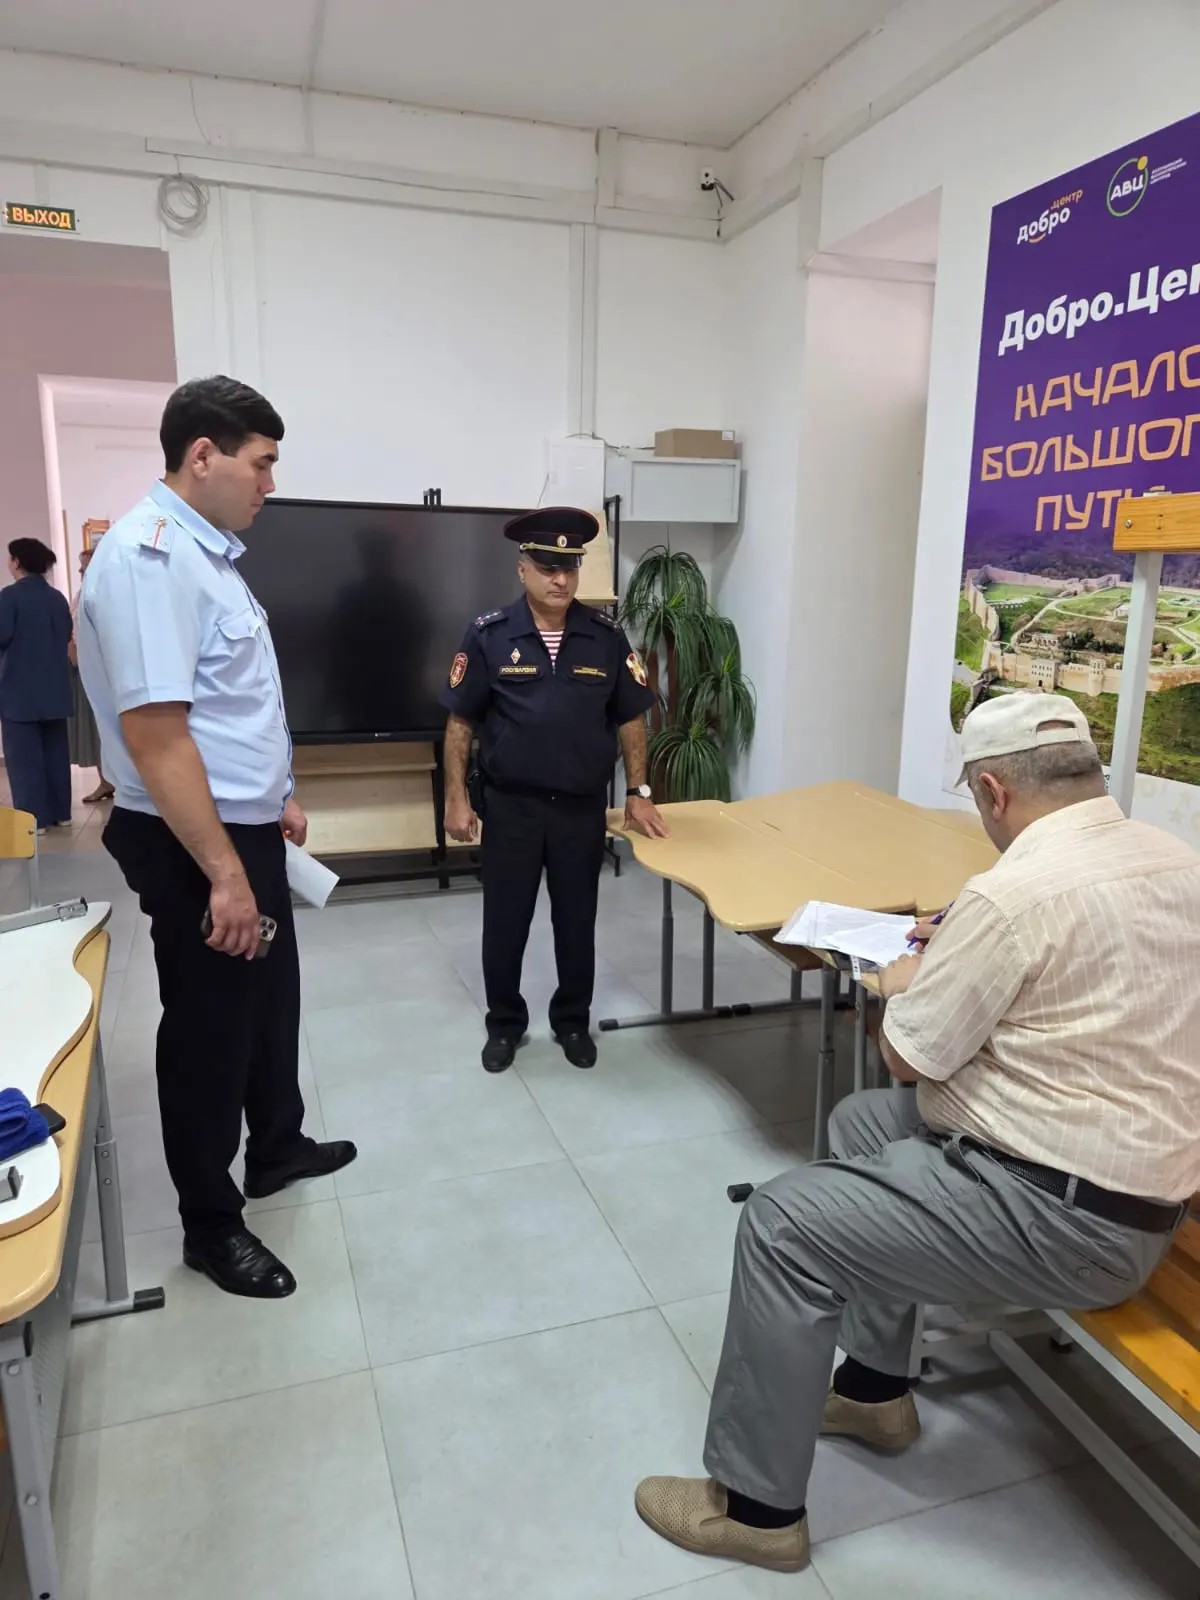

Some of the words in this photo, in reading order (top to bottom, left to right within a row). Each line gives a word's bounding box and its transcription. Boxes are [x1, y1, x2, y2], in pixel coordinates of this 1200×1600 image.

[1110, 174, 1145, 201] АВЦ
[12, 206, 72, 229] ВЫХОД
[1035, 485, 1166, 531] ПУТ
